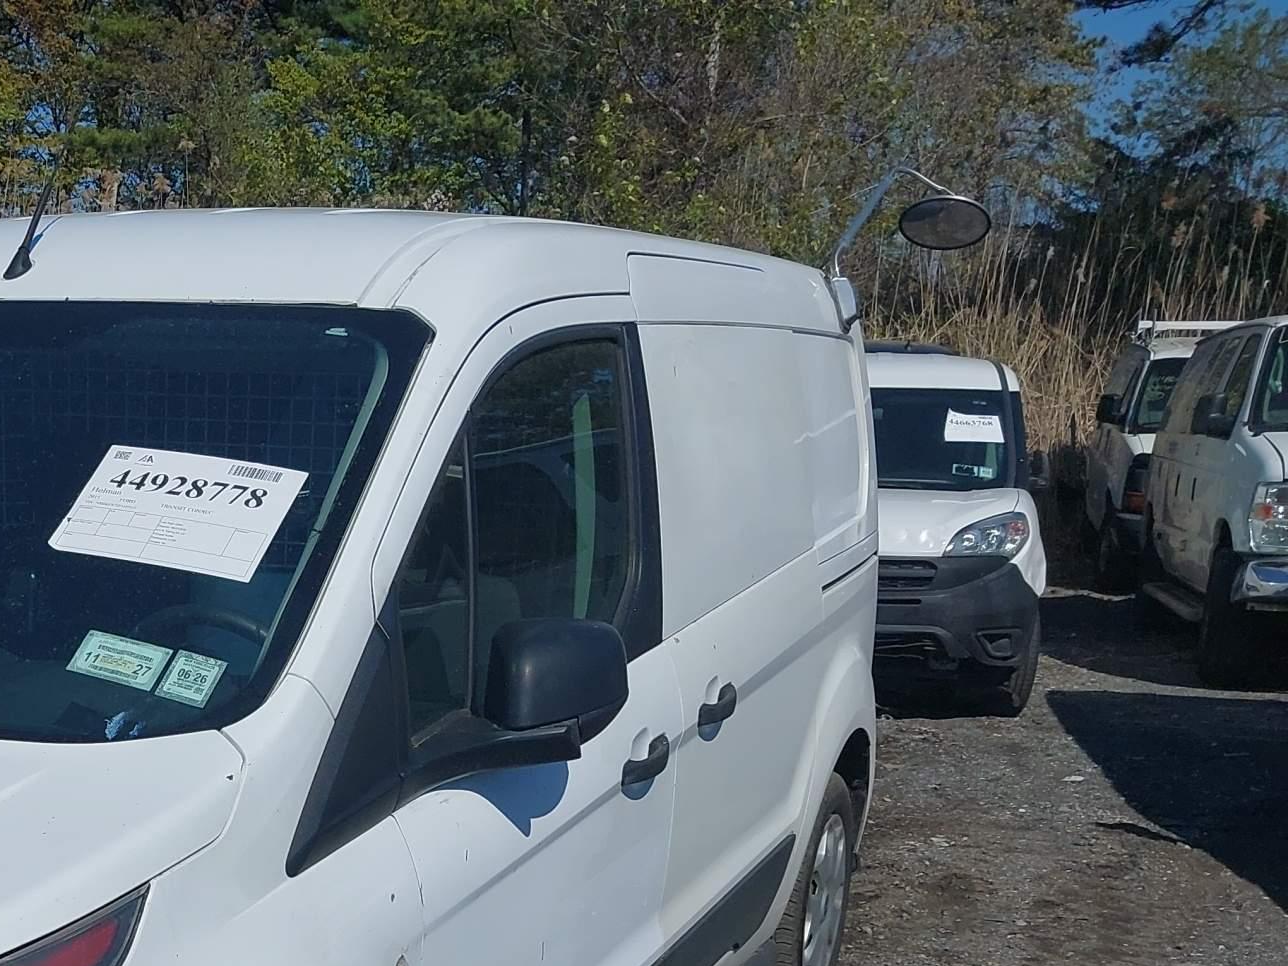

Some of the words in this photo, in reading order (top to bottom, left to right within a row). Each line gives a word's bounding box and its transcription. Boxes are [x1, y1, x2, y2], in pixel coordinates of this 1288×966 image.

[109, 468, 269, 510] 44928778
[84, 651, 101, 664] 11
[131, 664, 153, 677] 27
